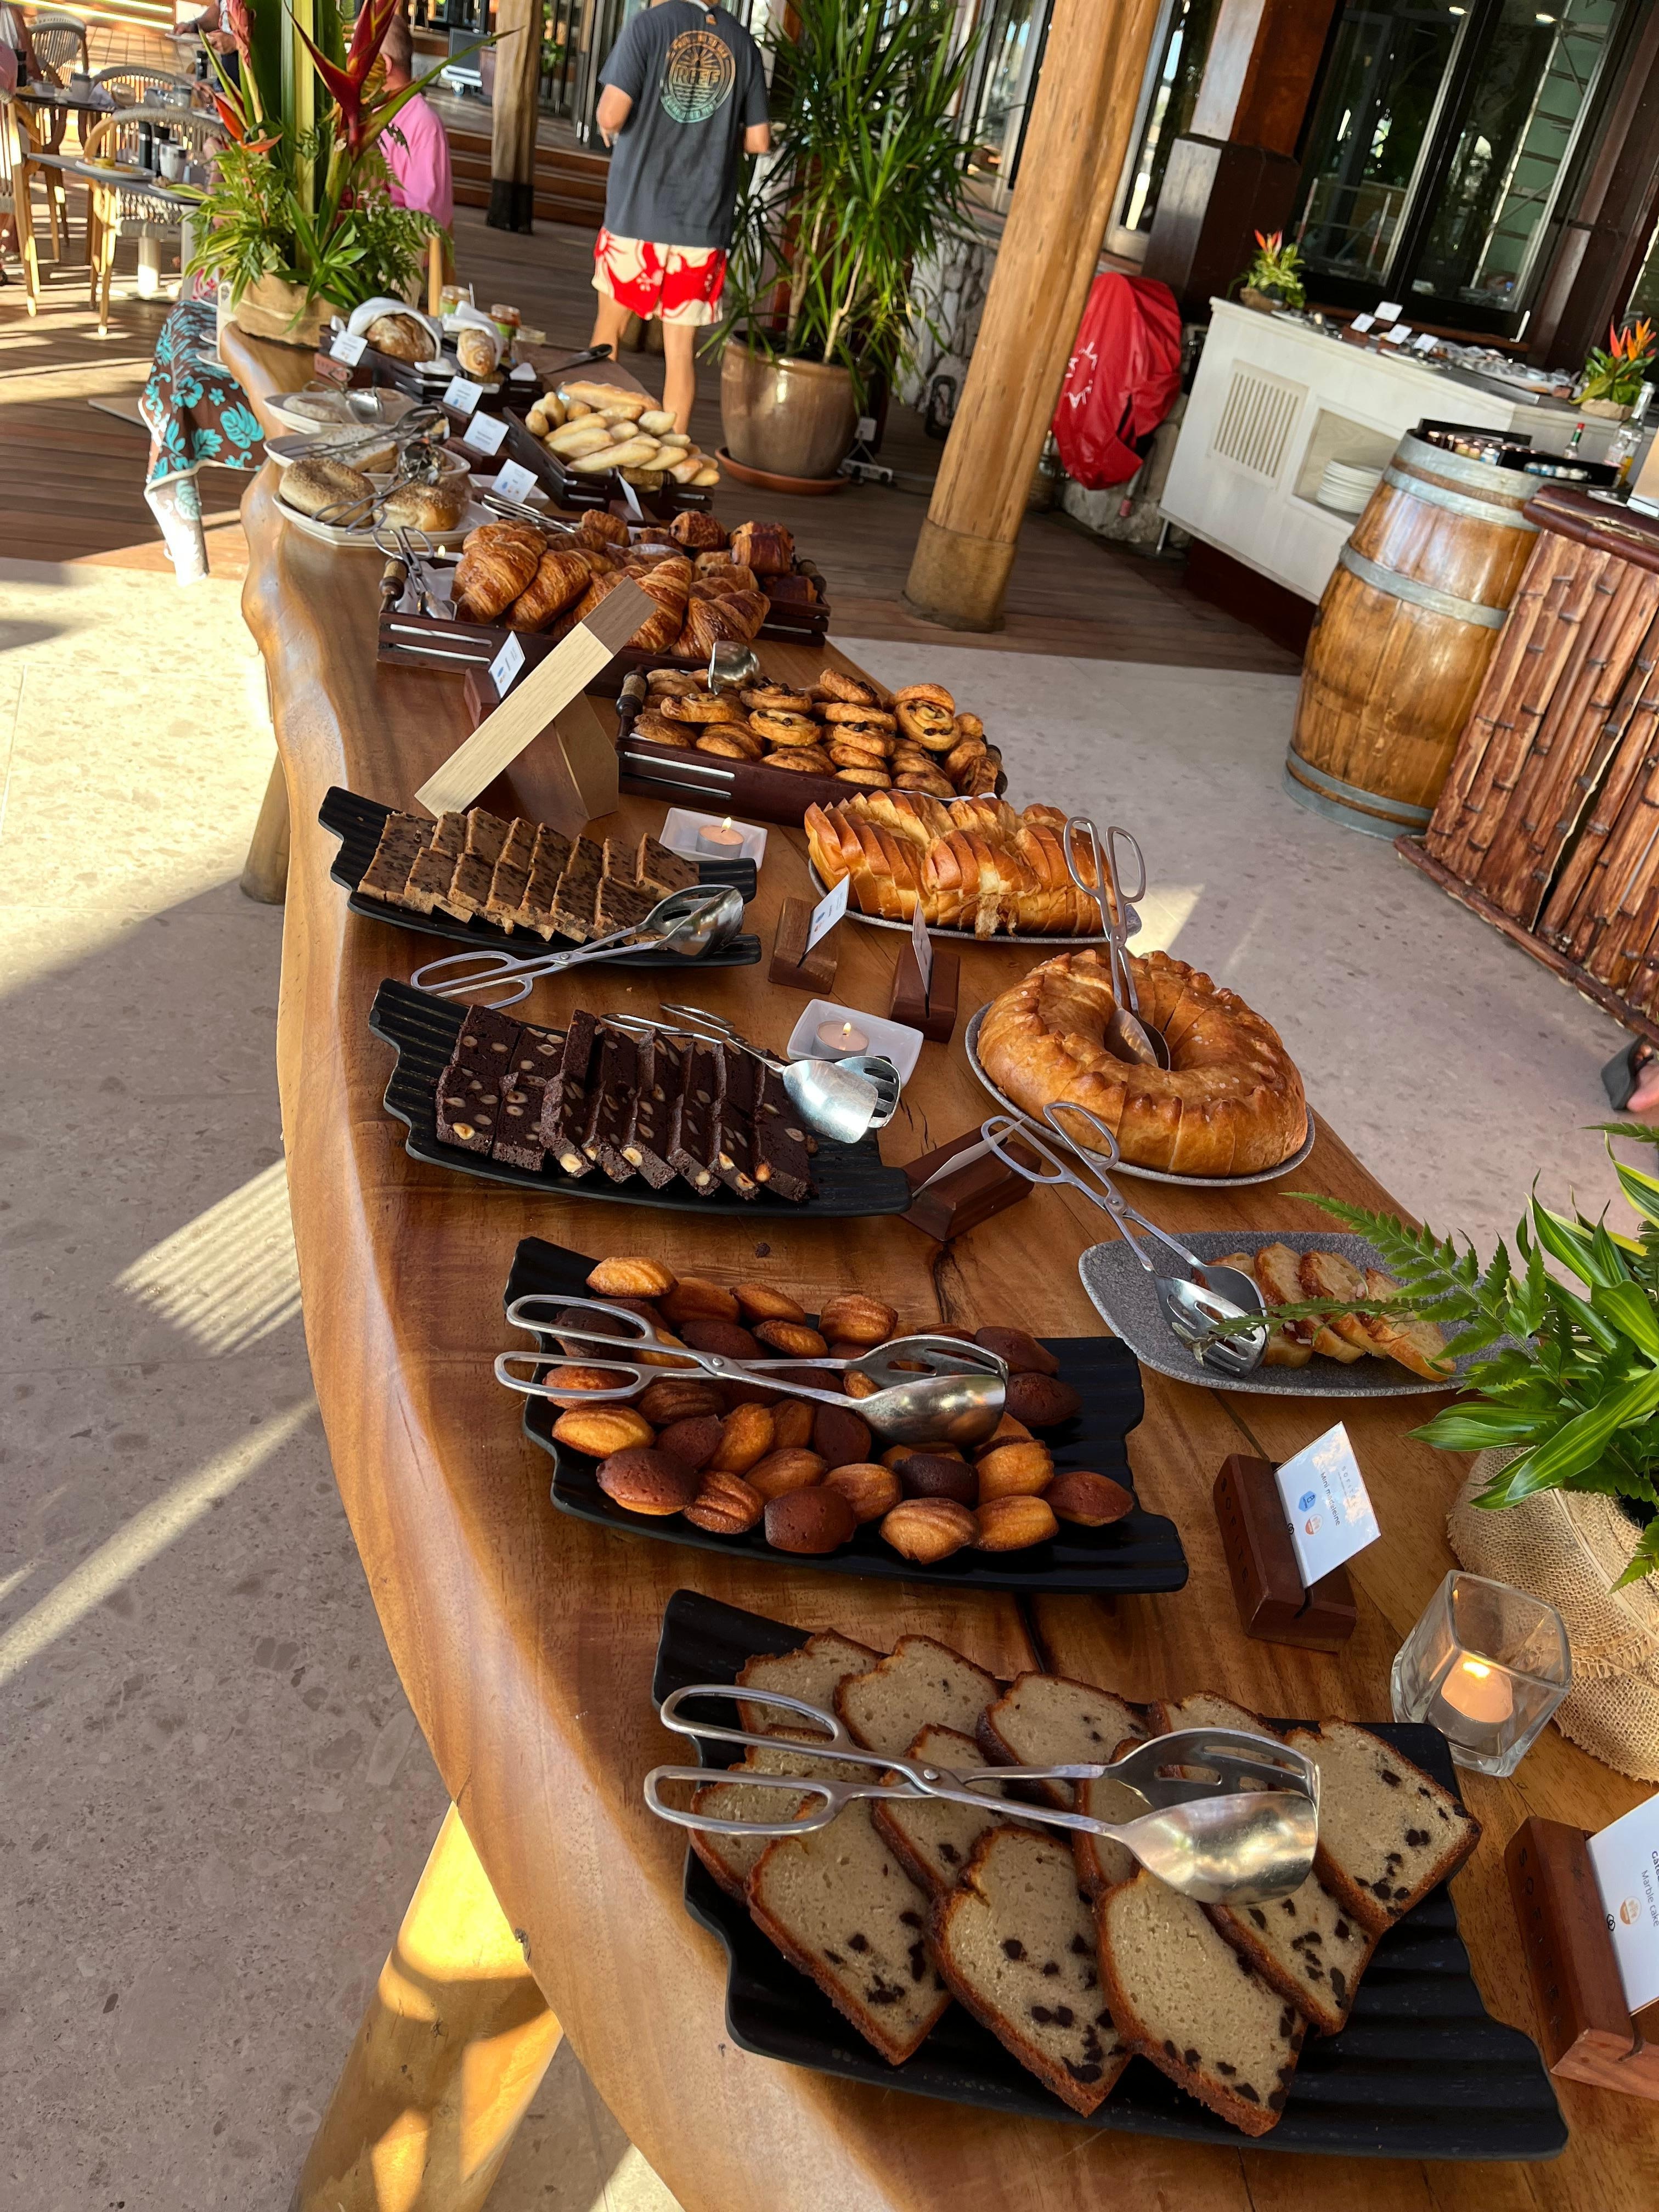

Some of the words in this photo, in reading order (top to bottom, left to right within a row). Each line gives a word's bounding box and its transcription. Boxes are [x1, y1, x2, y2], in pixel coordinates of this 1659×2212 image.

[673, 64, 721, 87] REEF
[1320, 1472, 1329, 1488] Mini
[1325, 1489, 1341, 1526] madeleine
[1221, 1477, 1250, 1591] SOFITE
[1641, 1870, 1654, 1904] Marble
[1650, 1904, 1659, 1927] cake
